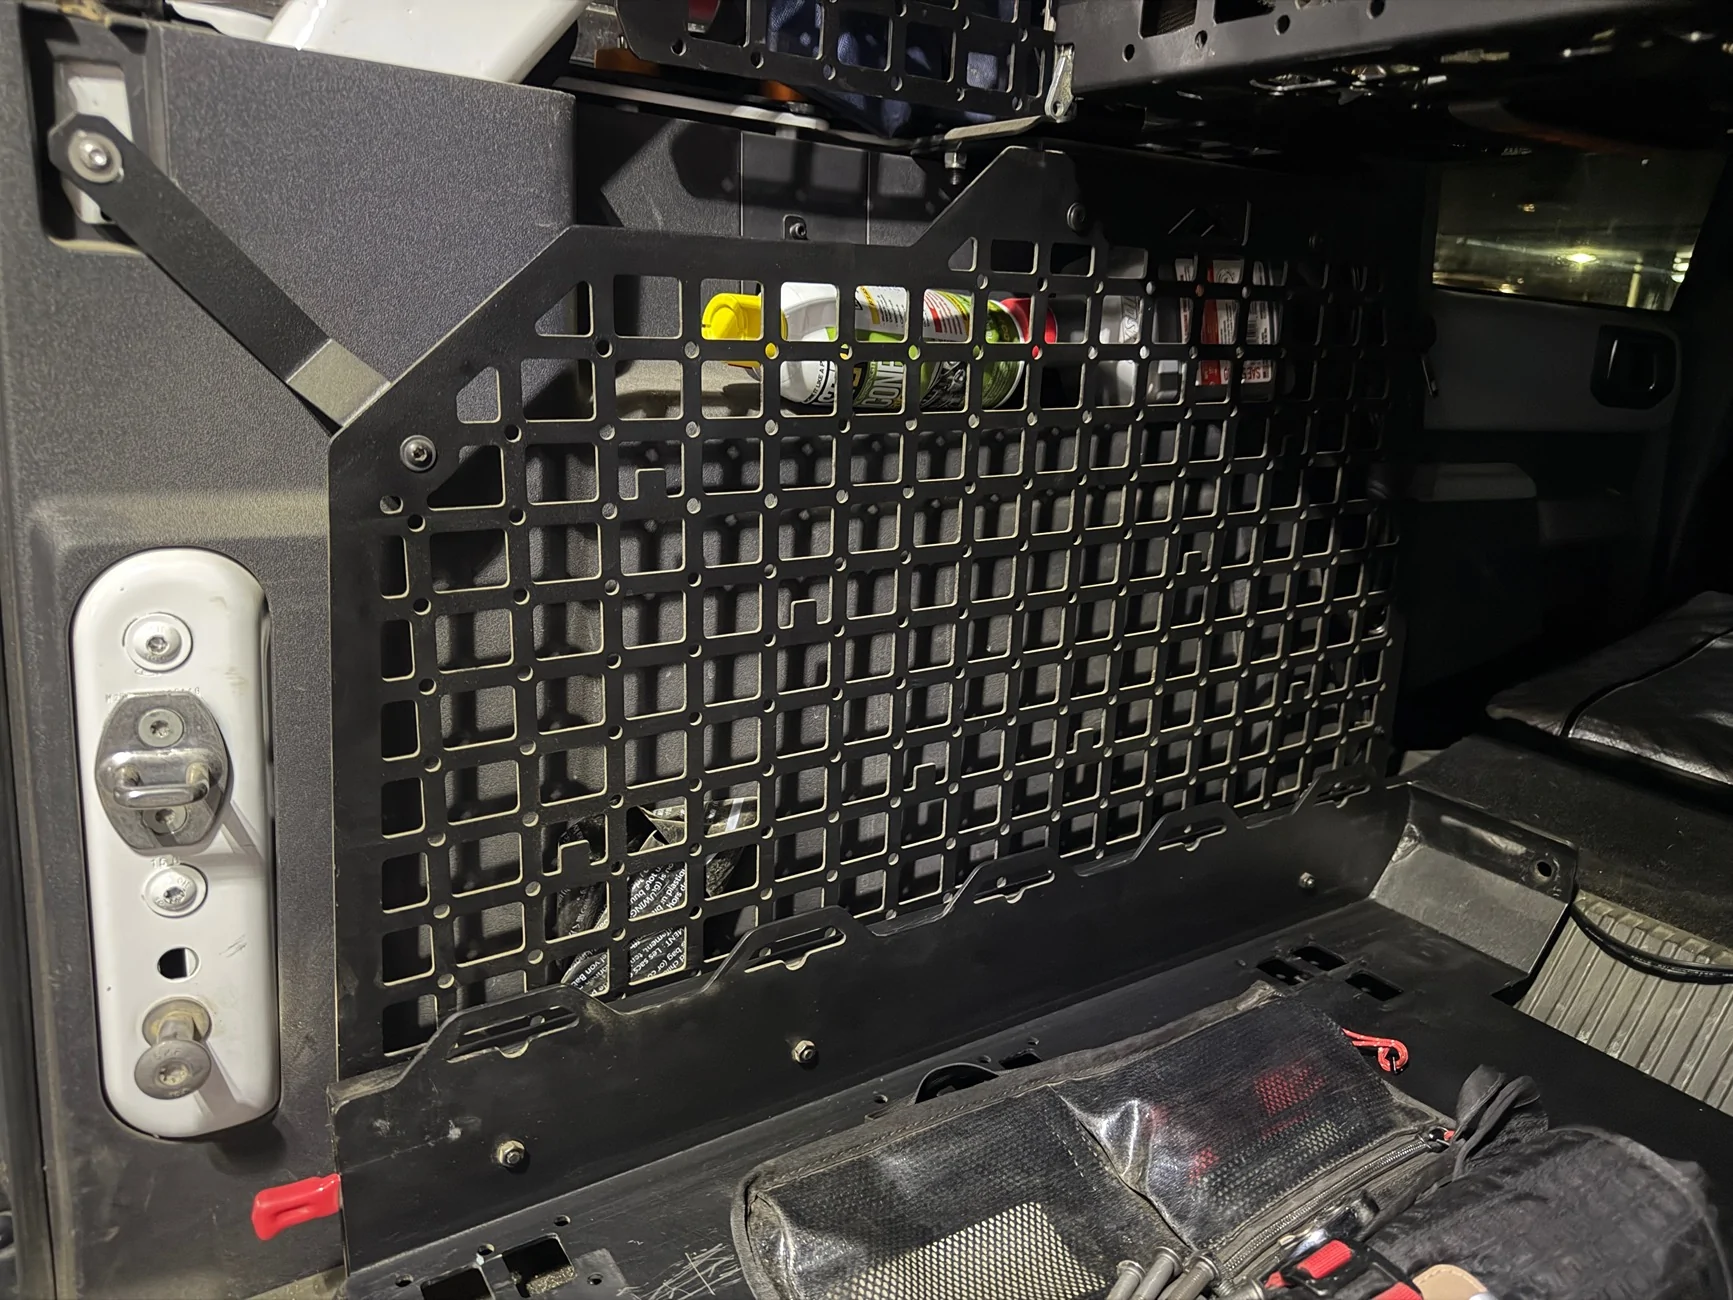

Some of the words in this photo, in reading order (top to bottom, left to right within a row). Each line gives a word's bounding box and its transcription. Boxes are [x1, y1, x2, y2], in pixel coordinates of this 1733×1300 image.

[667, 947, 682, 960] bag
[585, 961, 600, 975] von
[657, 960, 667, 972] (or
